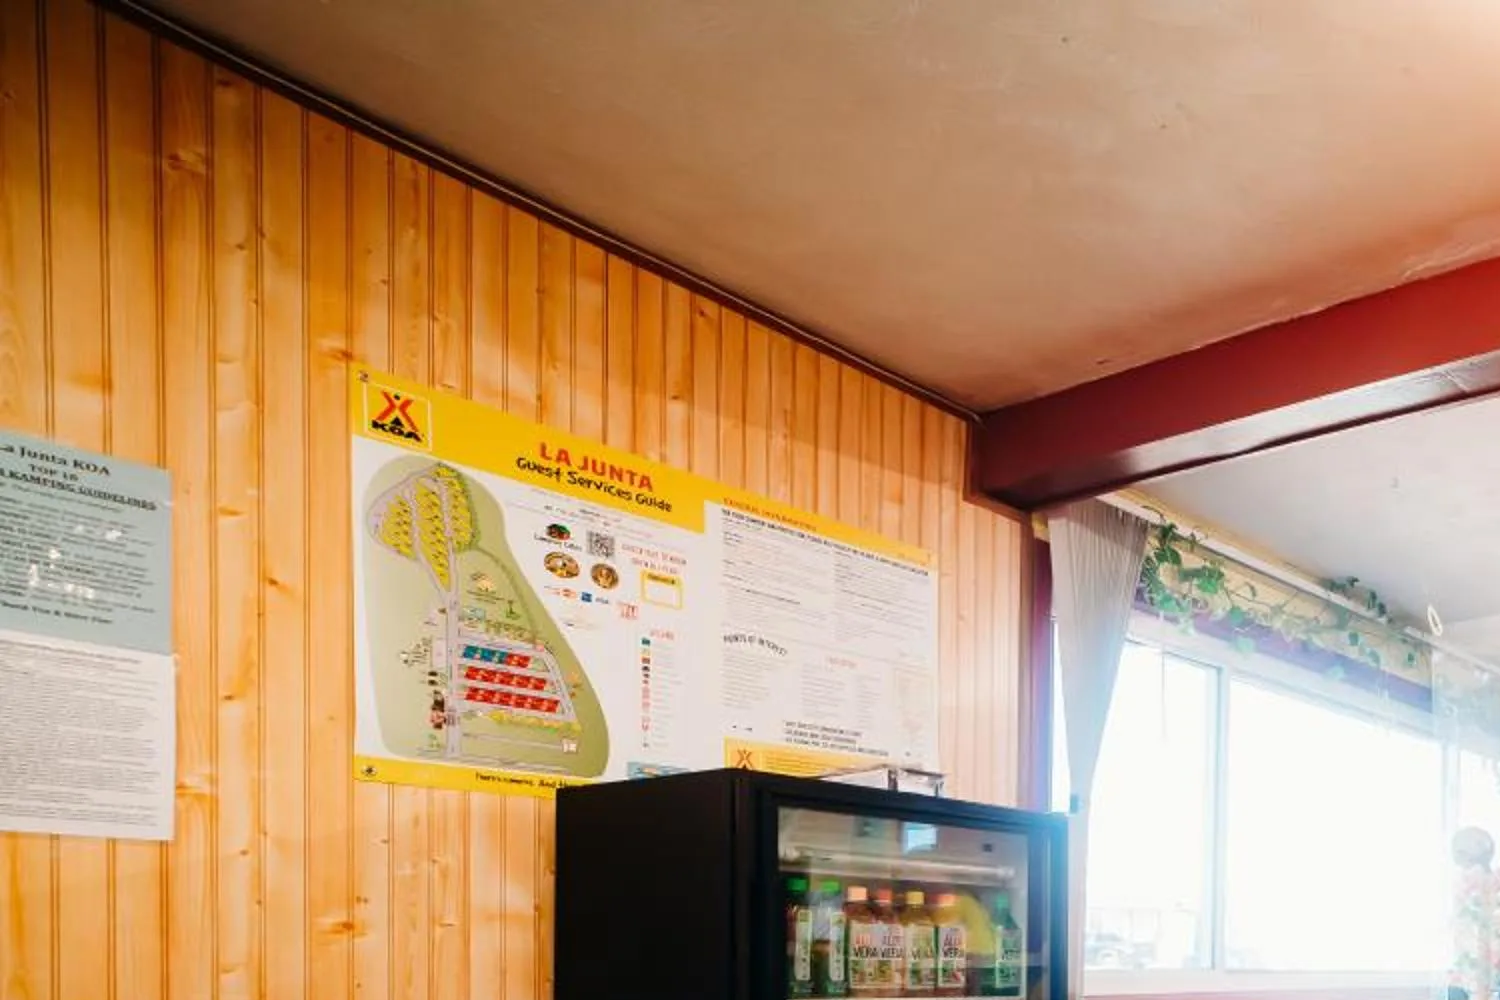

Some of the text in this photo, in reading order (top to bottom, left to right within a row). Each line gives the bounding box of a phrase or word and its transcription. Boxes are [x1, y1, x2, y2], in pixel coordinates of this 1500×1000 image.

[371, 418, 423, 443] KOA
[19, 446, 68, 466] Junta
[72, 458, 110, 476] KOA
[28, 463, 58, 476] TOP
[539, 442, 654, 492] LA JUNTA
[516, 456, 673, 513] Guest Services Guide
